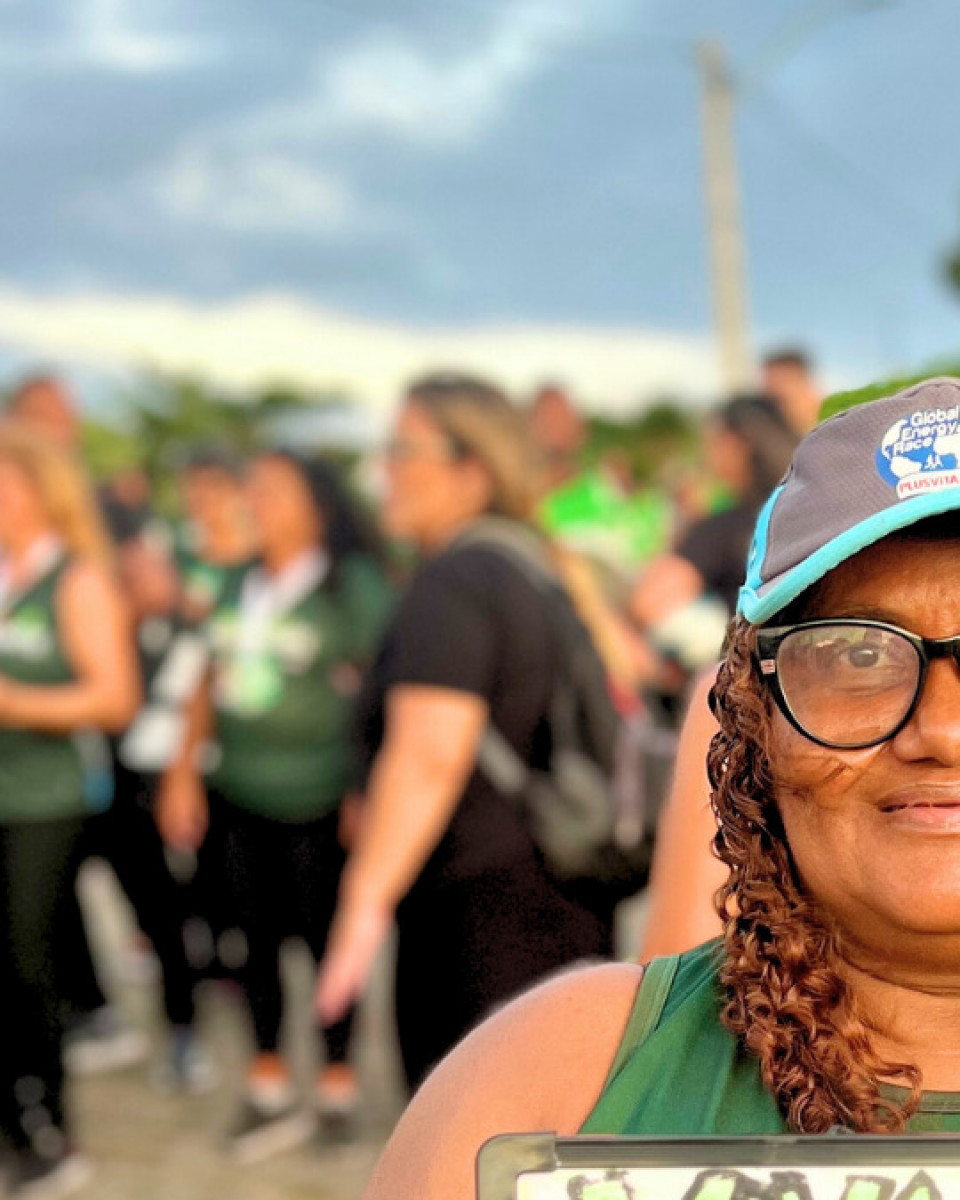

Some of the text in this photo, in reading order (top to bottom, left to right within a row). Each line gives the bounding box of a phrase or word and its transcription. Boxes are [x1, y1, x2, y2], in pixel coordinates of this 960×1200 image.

[911, 405, 960, 426] Global
[901, 421, 957, 439] Energy
[899, 475, 959, 493] PLUSVITA
